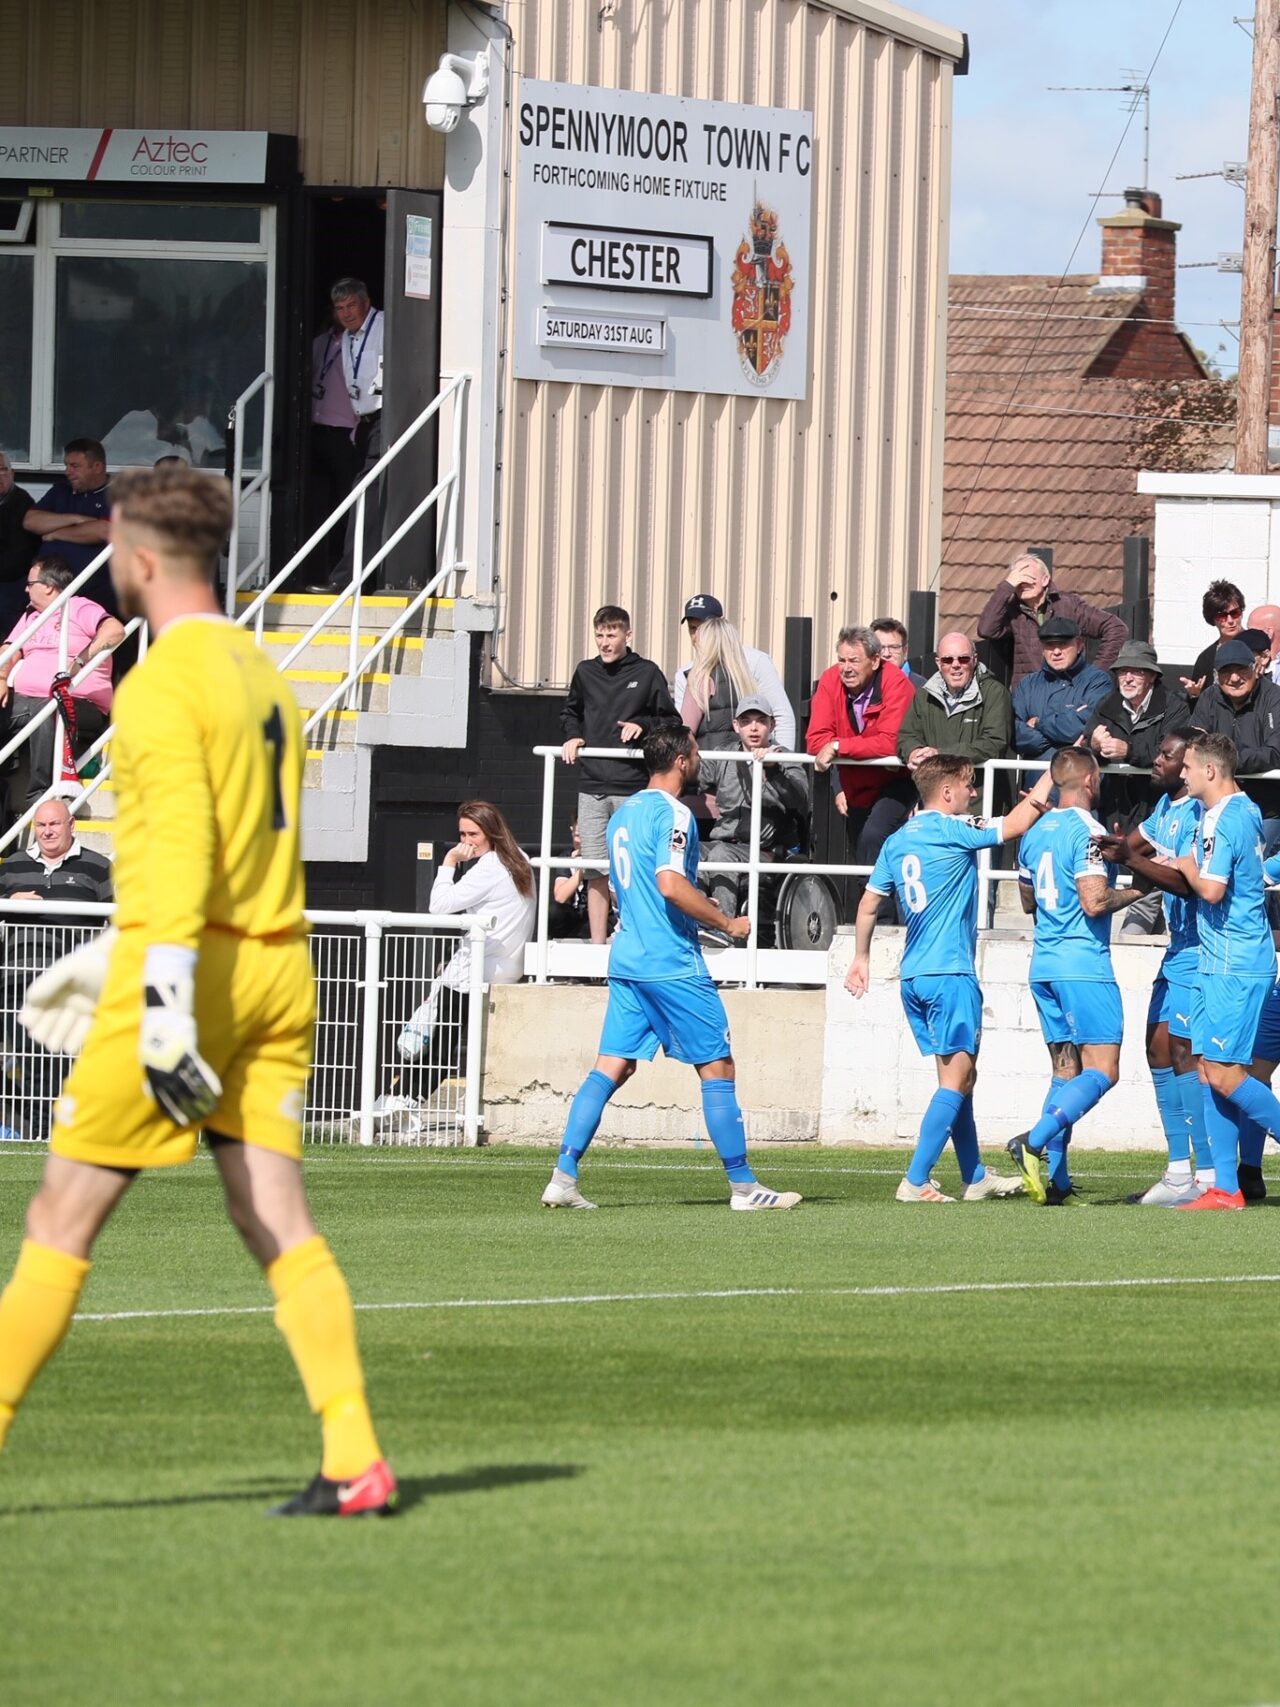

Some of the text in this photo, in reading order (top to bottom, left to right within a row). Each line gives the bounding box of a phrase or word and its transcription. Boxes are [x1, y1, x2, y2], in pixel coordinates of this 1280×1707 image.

[132, 136, 209, 163] Aztec
[519, 102, 688, 163] SPENNYMOOR
[703, 123, 771, 172] TOWN
[130, 164, 207, 177] COLOUR PRINT
[533, 163, 727, 202] FORTHCOMING HOME FIXTURE
[571, 238, 681, 284] CHESTER
[546, 320, 652, 344] SATURDAY 31ST AUG
[263, 703, 286, 831] 1
[612, 826, 632, 890] 6
[900, 853, 928, 914] 8
[1035, 850, 1060, 911] 4
